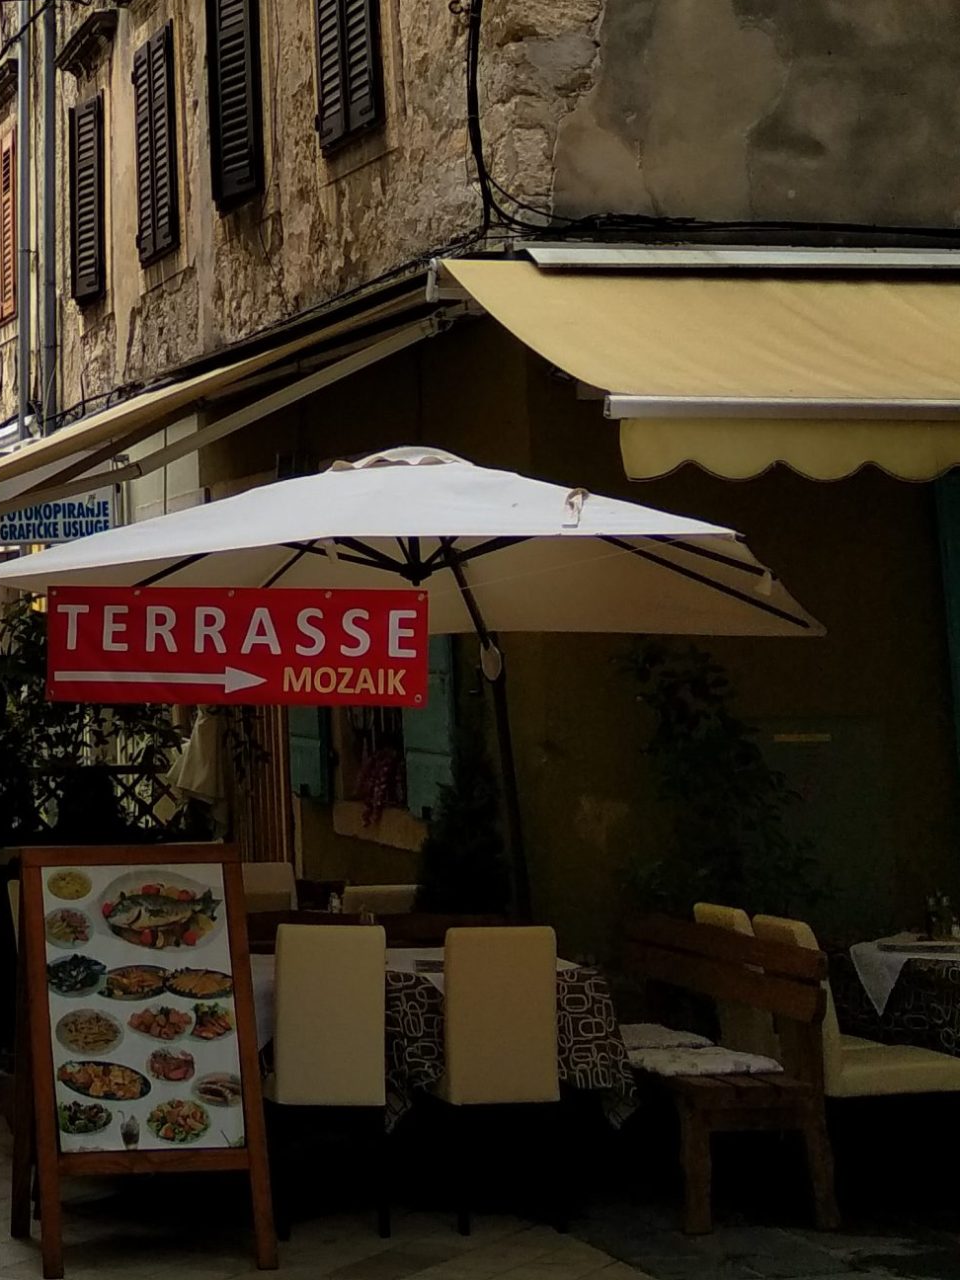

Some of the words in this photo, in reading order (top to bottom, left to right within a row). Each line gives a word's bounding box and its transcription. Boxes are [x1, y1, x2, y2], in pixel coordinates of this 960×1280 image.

[63, 519, 109, 538] USLUGE
[56, 604, 417, 658] TERRASSE
[282, 666, 406, 696] MOZAIK
